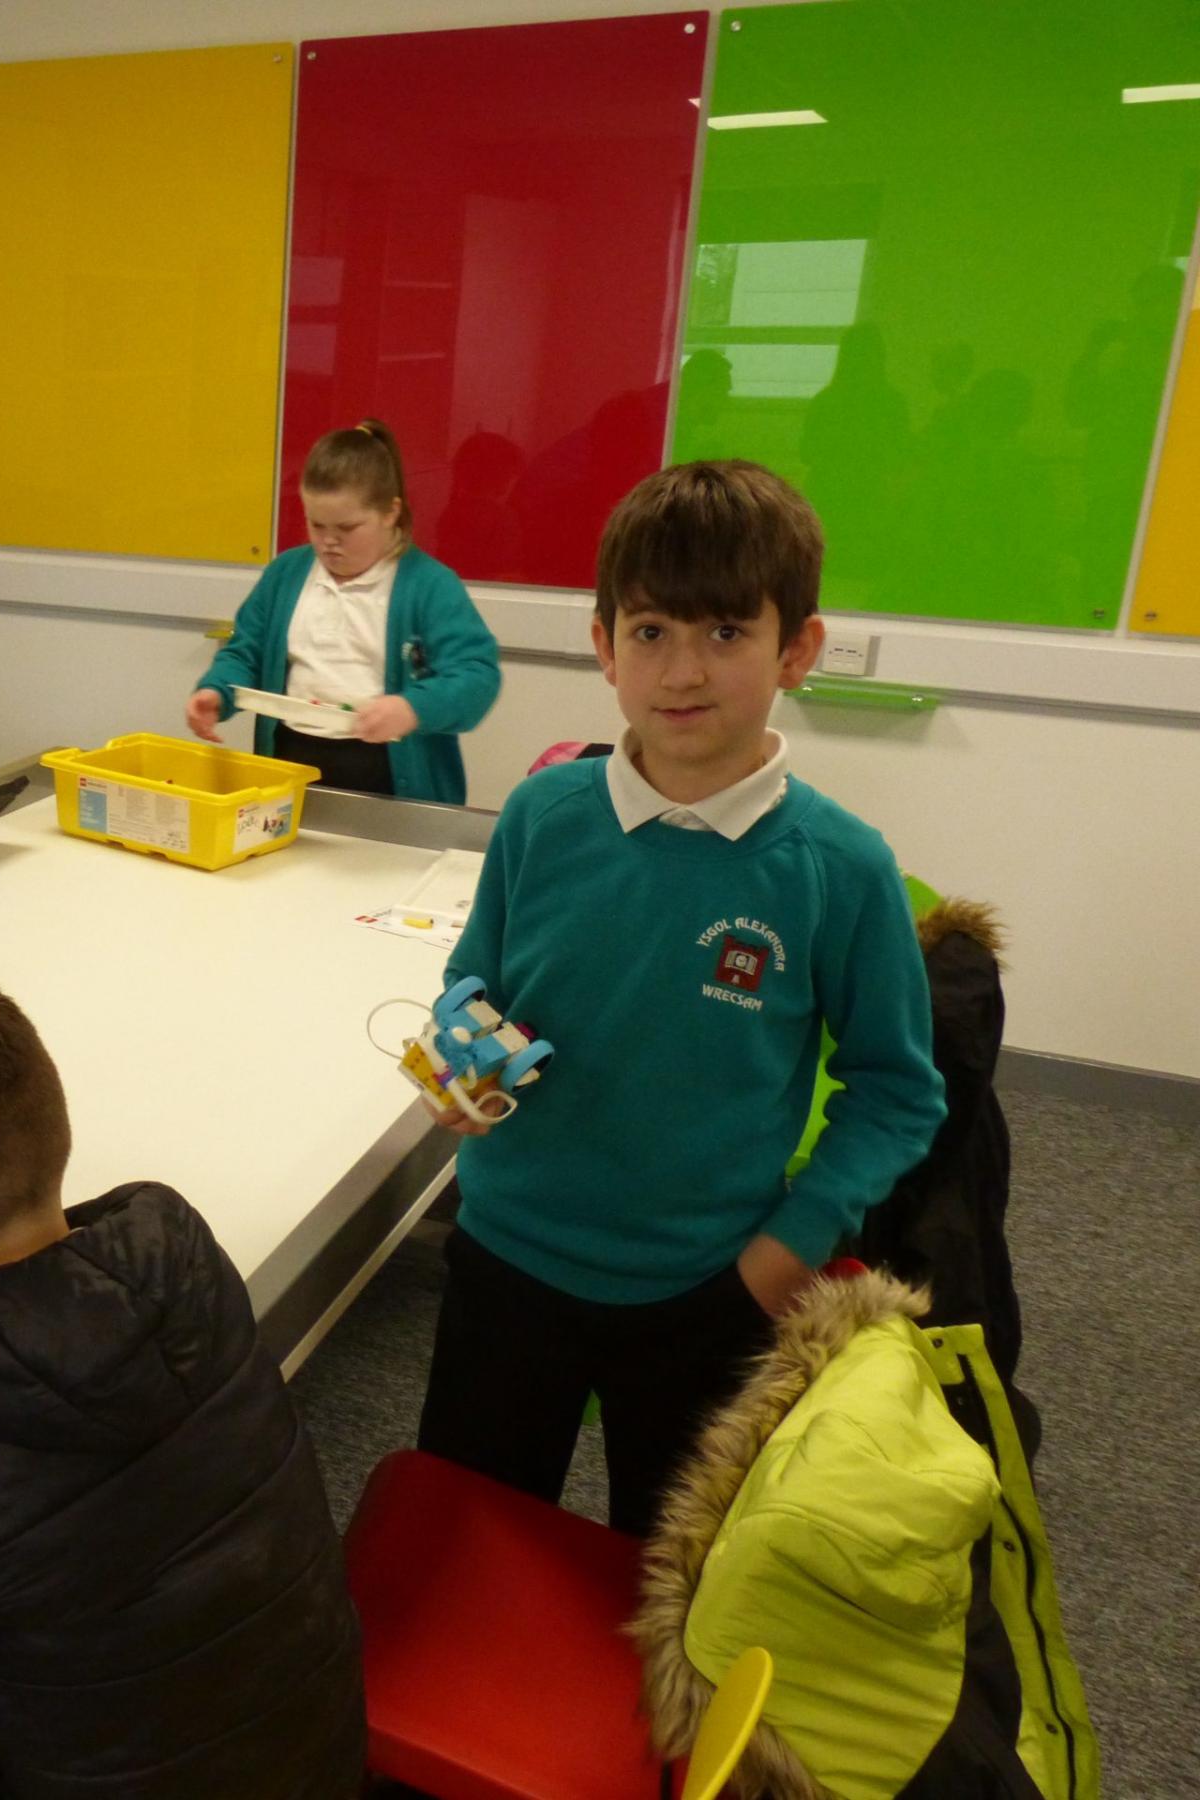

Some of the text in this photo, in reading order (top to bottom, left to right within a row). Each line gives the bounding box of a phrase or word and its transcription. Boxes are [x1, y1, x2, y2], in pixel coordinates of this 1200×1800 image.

[696, 916, 786, 972] YSGOL ALEXANDRA
[702, 983, 763, 1011] WRECSAM
